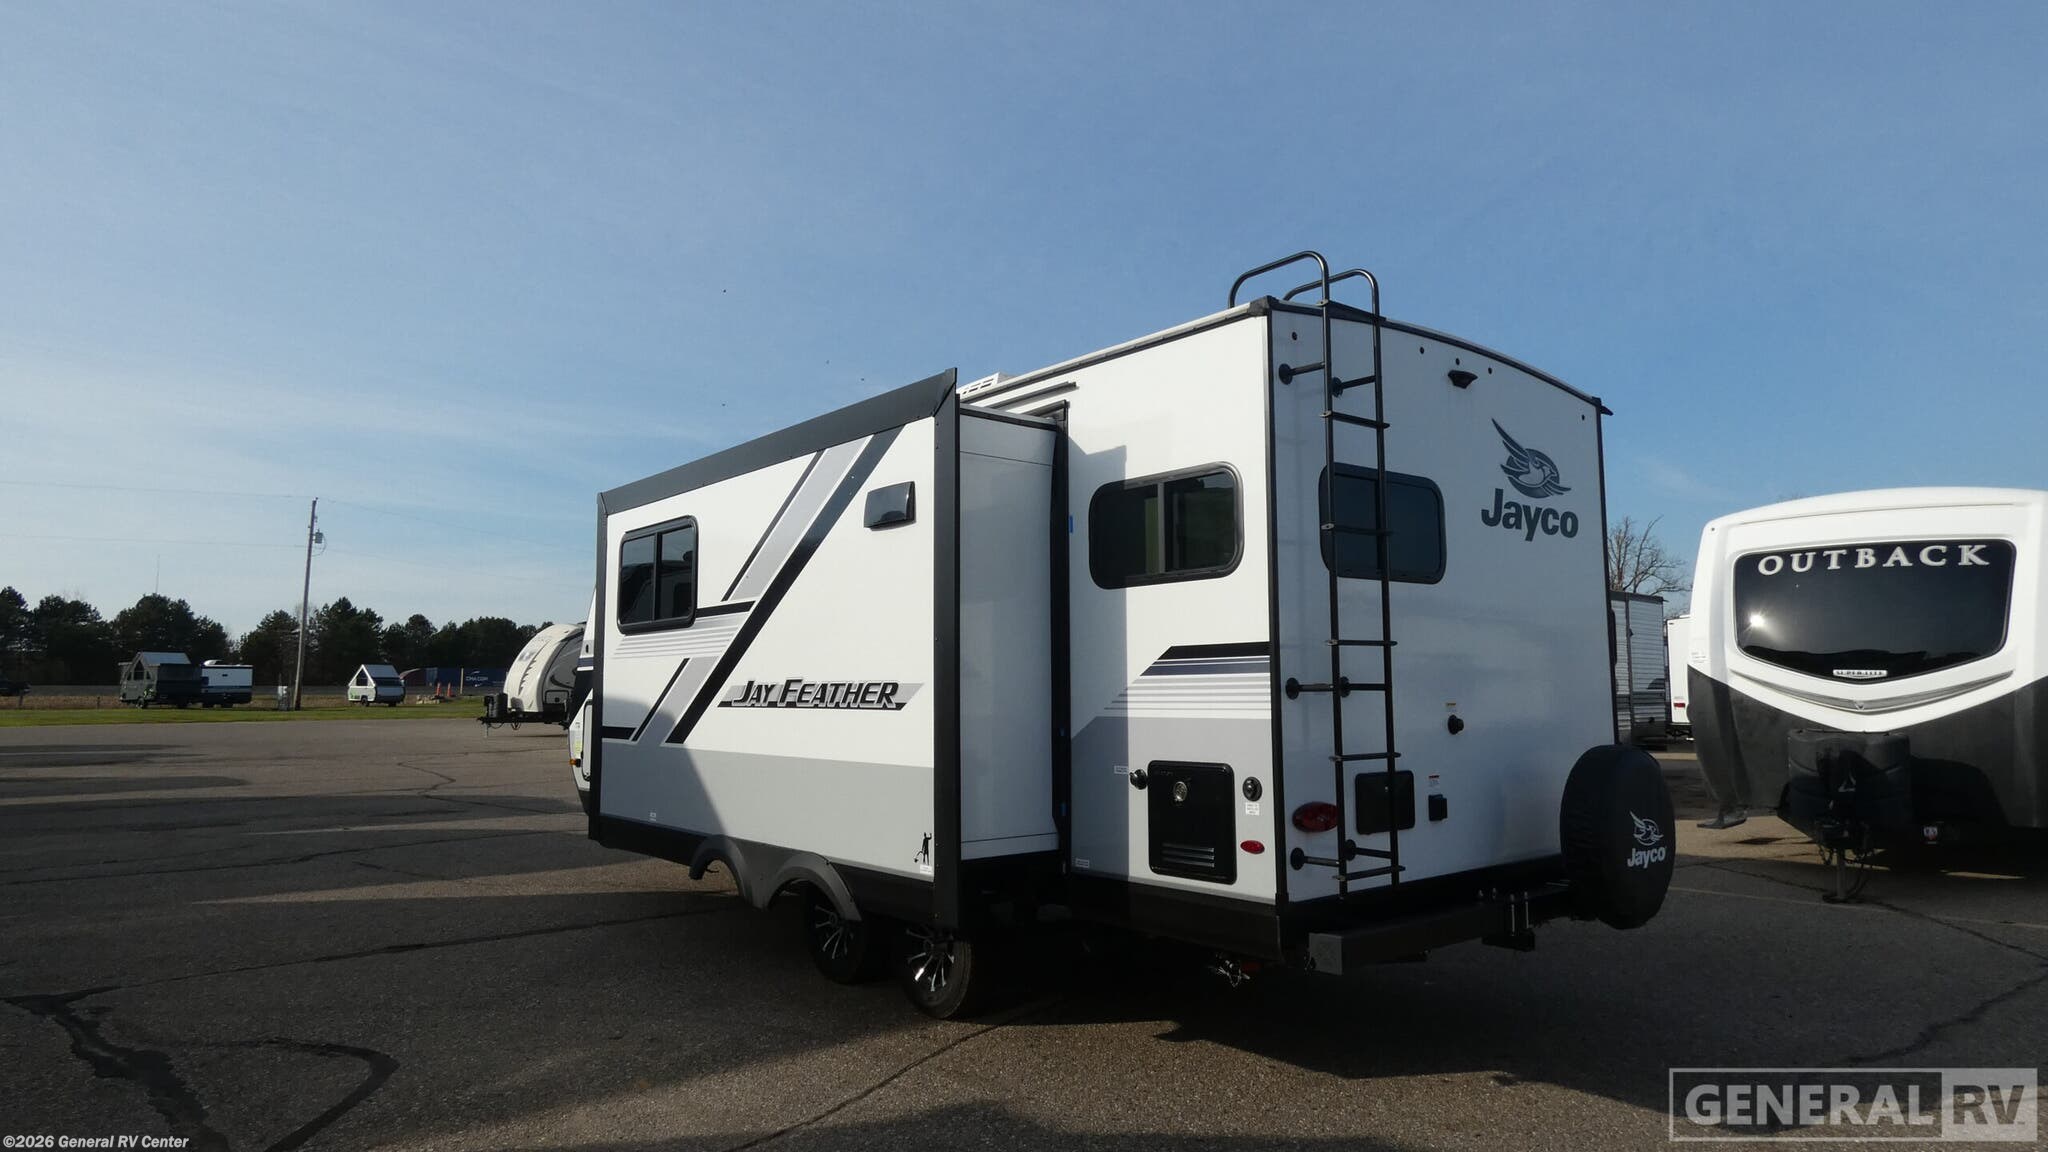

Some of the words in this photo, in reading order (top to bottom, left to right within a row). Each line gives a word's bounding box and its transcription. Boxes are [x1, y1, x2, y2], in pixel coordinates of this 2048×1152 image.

[1481, 488, 1579, 542] Jayco
[1758, 544, 1990, 576] OUTBACK
[777, 678, 898, 708] FEATHER
[1627, 846, 1667, 869] Jayco
